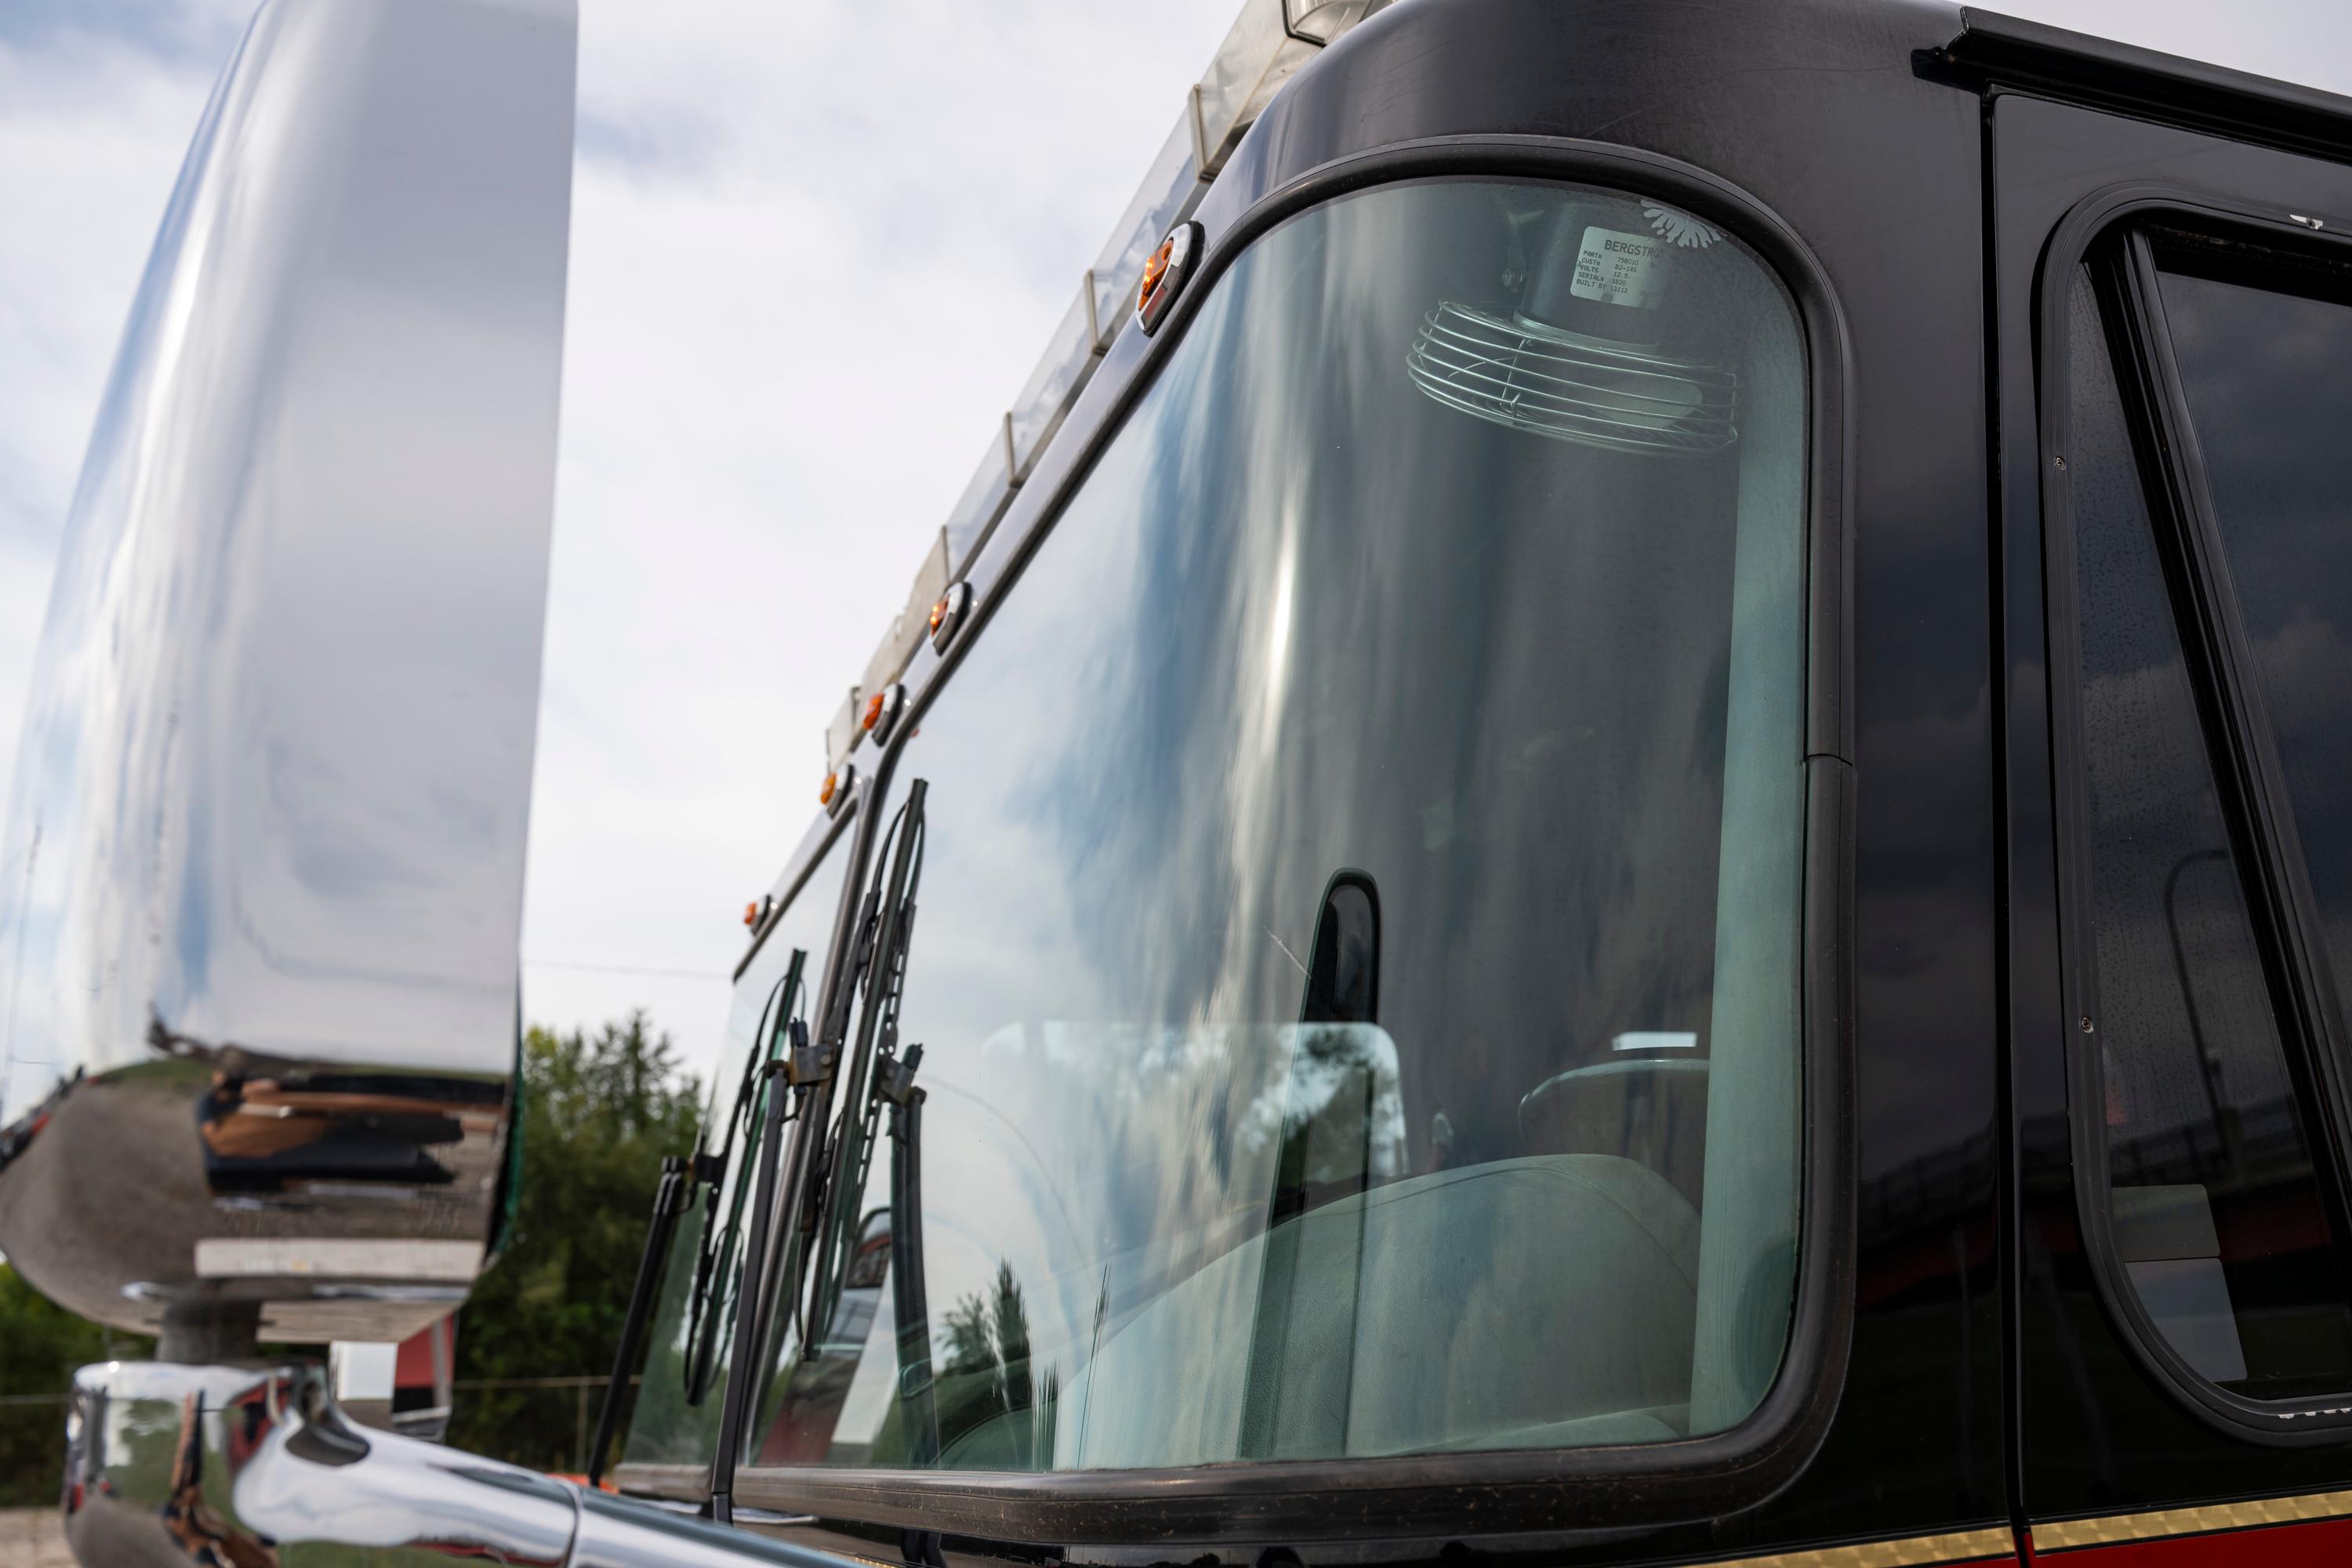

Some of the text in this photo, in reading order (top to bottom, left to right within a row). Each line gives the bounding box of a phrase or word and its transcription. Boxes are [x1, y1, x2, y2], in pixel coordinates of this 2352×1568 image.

[1583, 250, 1602, 259] PART#
[1581, 257, 1600, 266] CUST#
[1578, 271, 1605, 281] SERIAL#
[1576, 278, 1595, 288] BUILT
